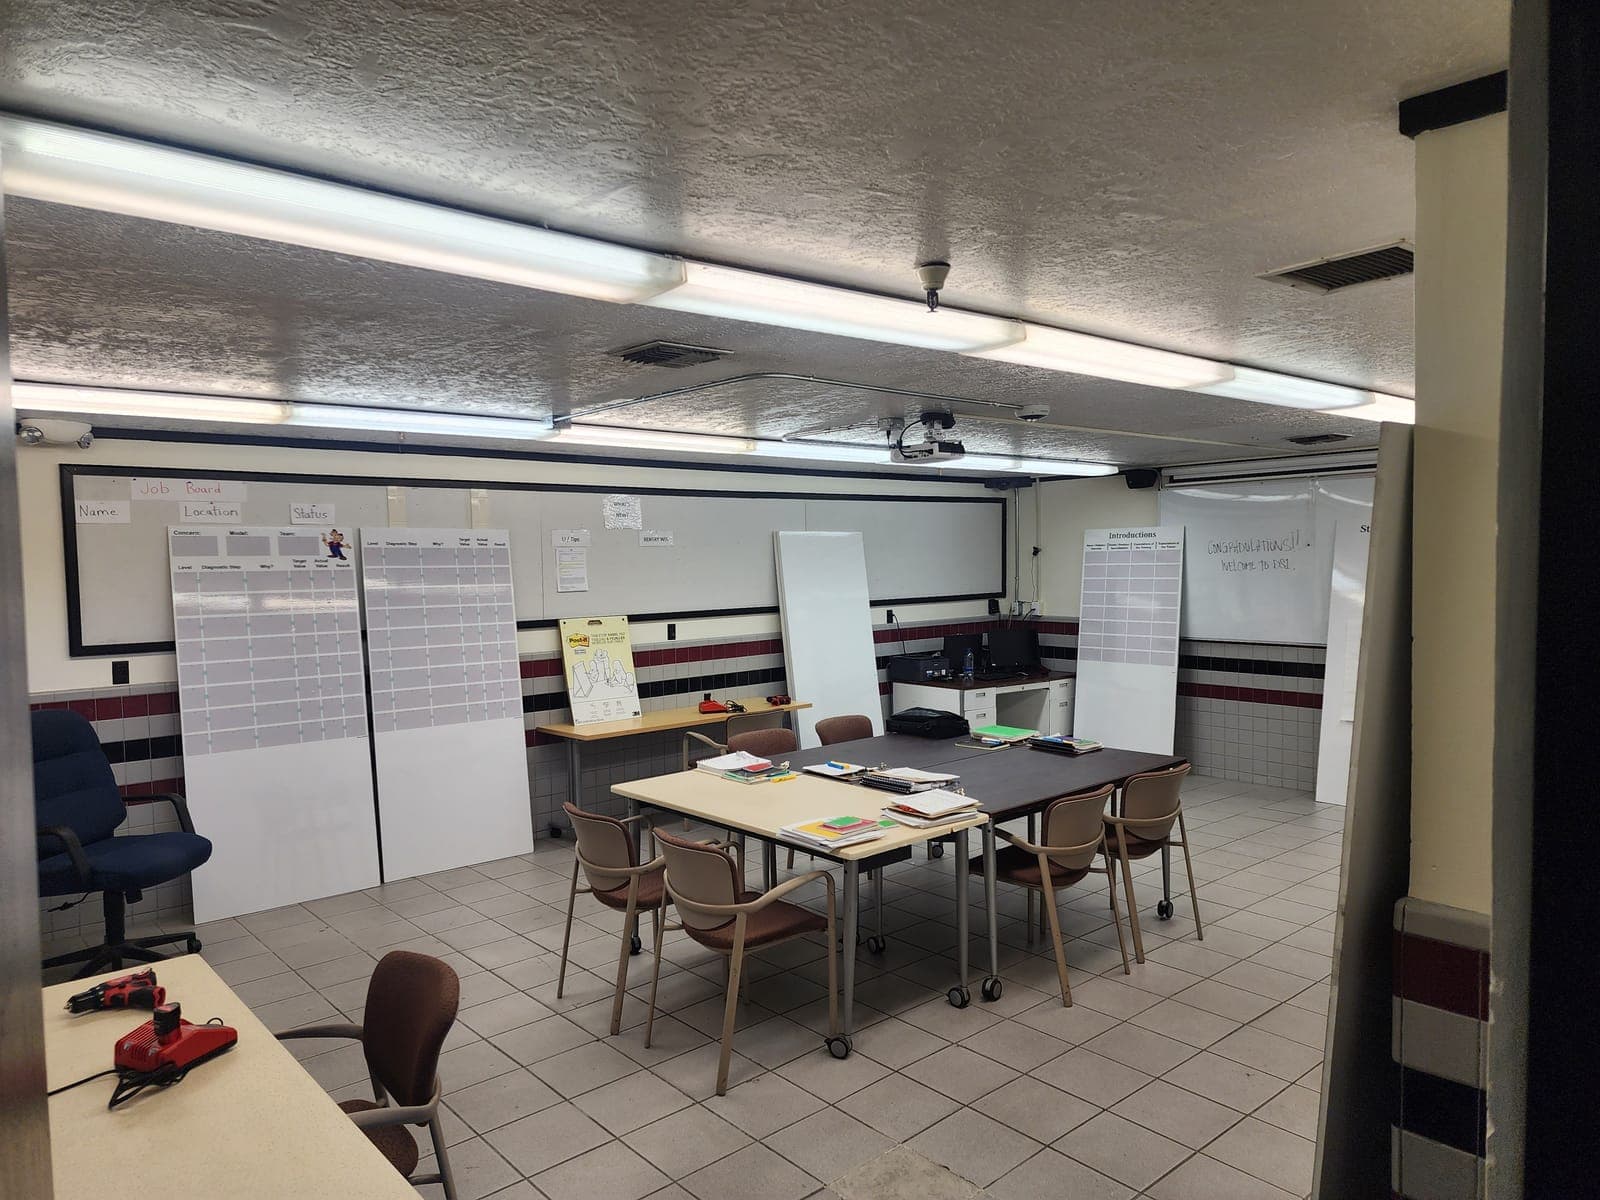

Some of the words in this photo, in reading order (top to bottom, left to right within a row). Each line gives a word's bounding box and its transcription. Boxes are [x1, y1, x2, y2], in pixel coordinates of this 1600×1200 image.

[140, 481, 170, 495] Job
[185, 482, 221, 495] Board
[79, 505, 119, 517] Name
[184, 504, 239, 518] Location
[293, 507, 328, 519] Status
[1109, 531, 1157, 540] Introductions
[1260, 560, 1270, 572] TO
